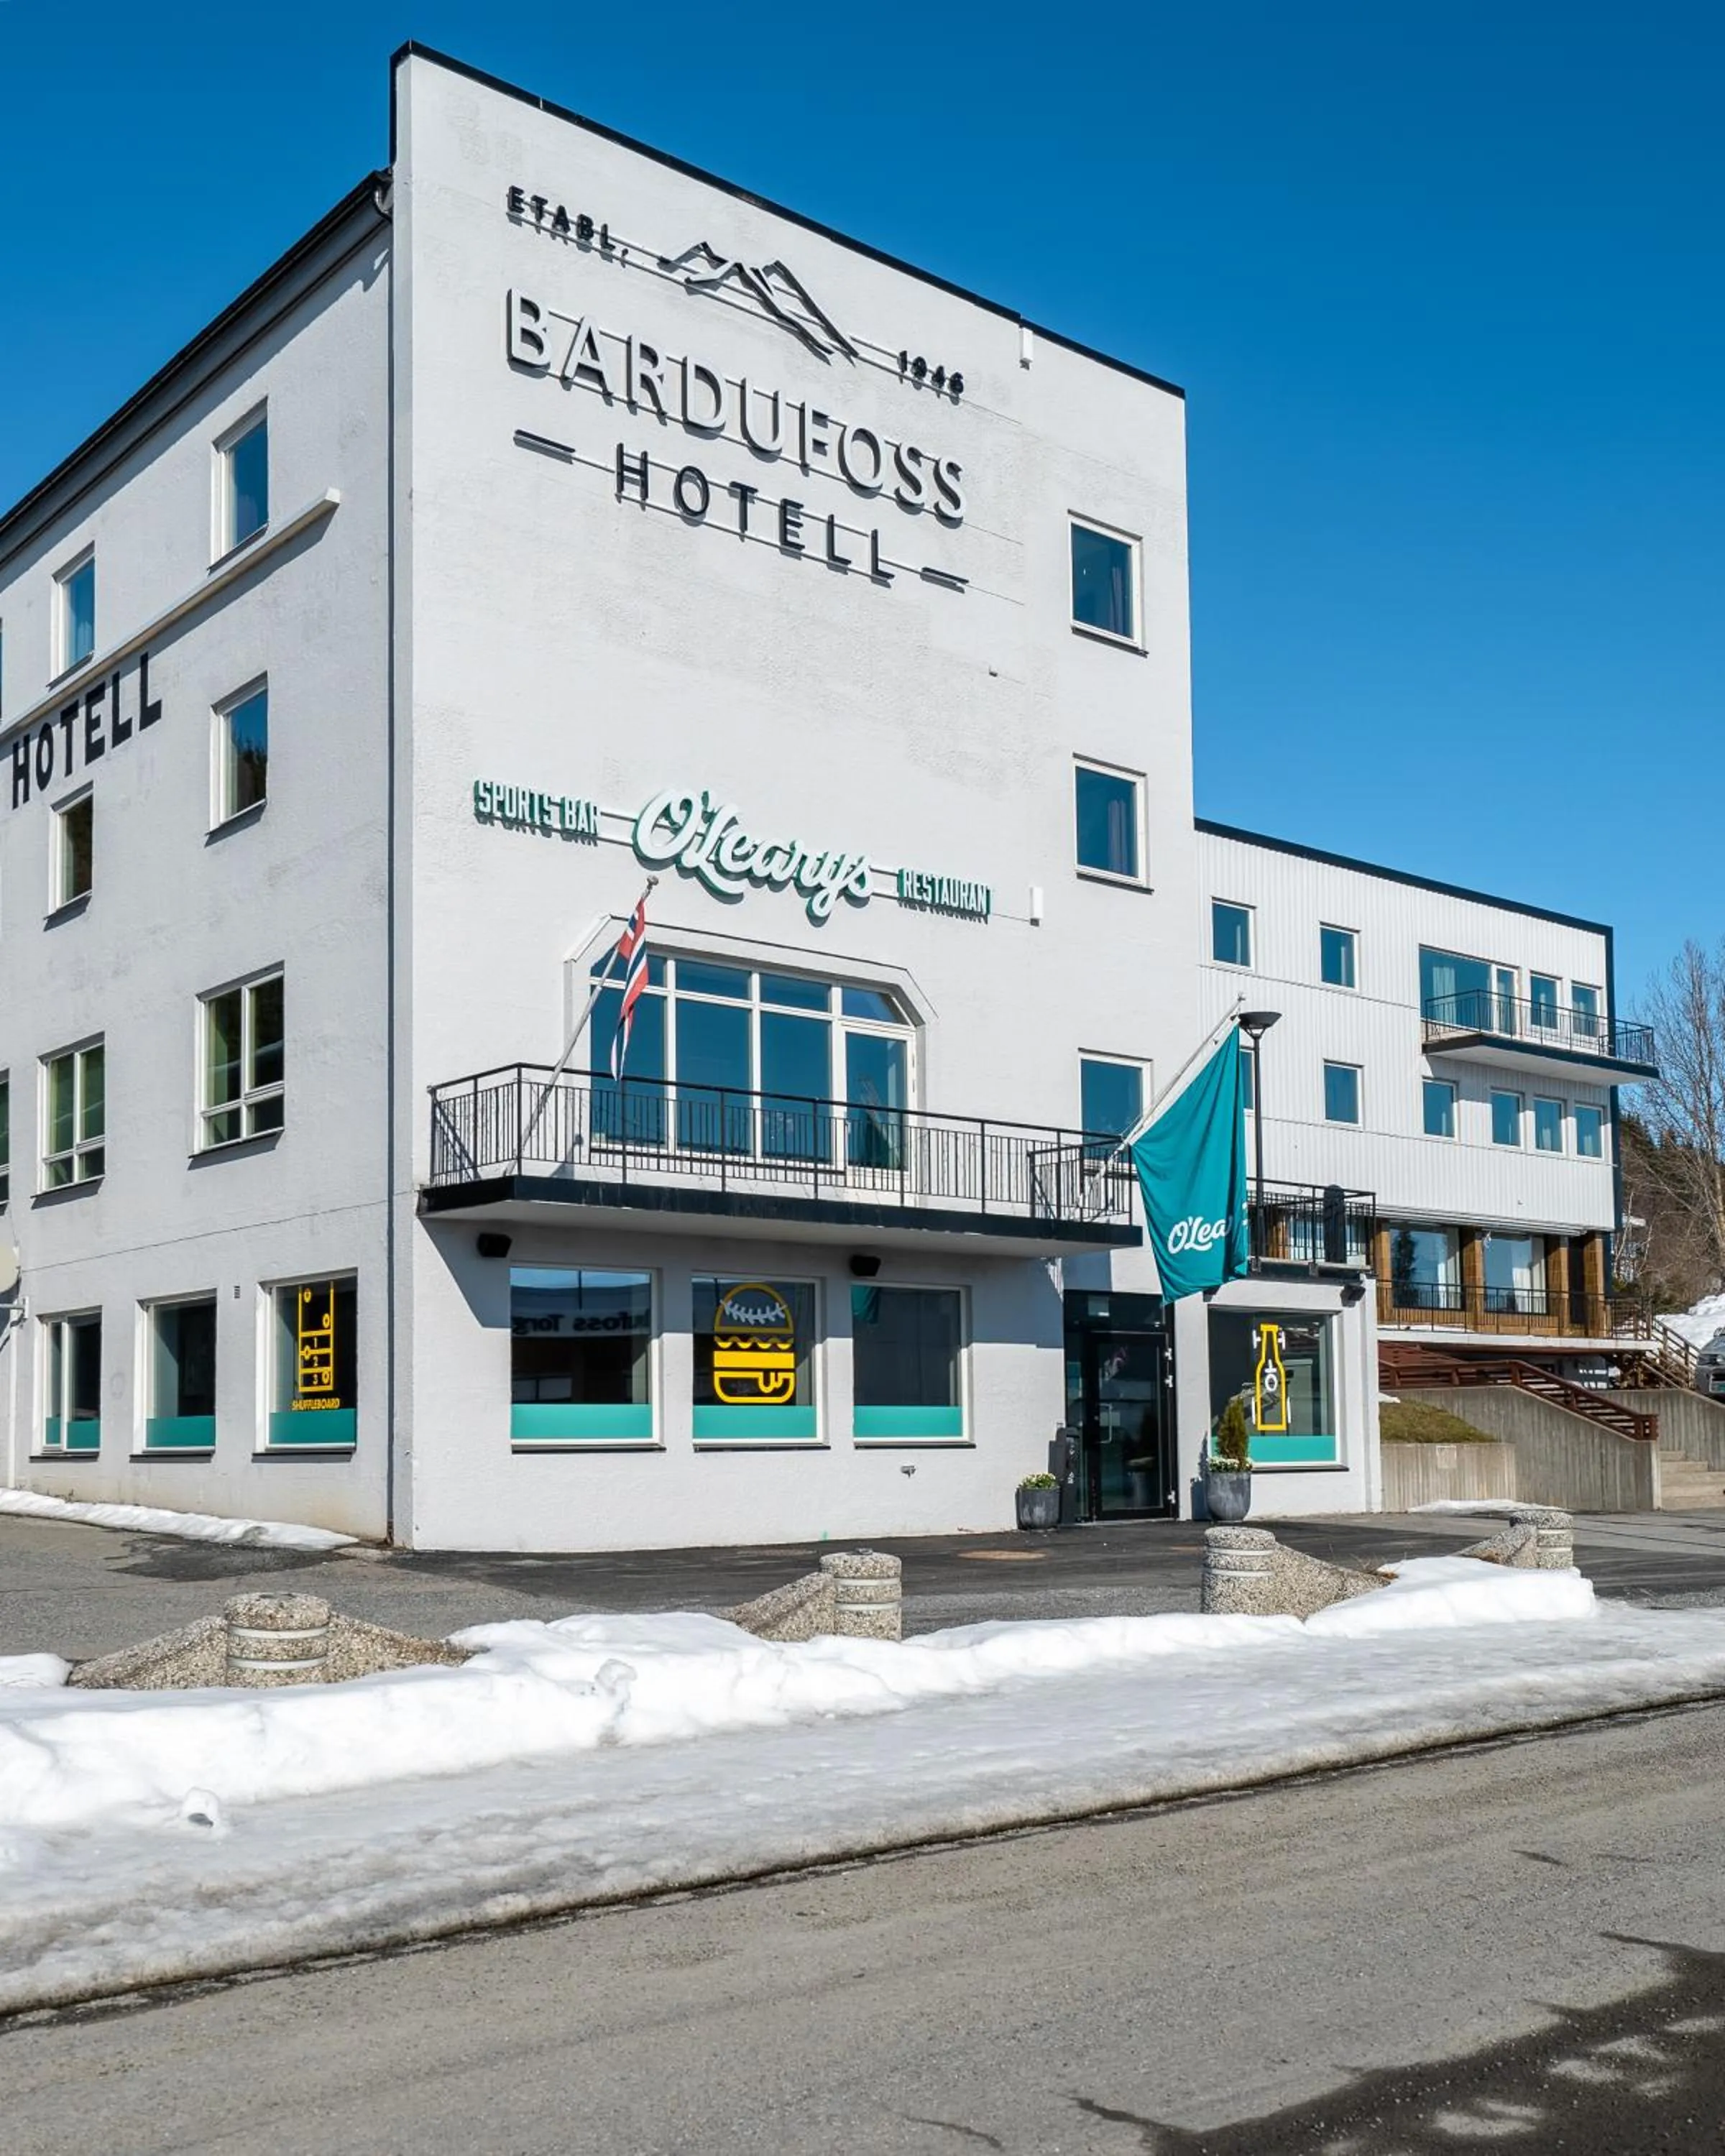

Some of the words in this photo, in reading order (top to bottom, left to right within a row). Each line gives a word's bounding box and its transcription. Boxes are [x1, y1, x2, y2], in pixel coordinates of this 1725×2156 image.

[898, 350, 964, 395] 1946
[507, 288, 969, 519] BARDUFOSS
[616, 442, 895, 580] HOTELL
[12, 651, 162, 811] HOTELL
[474, 779, 553, 826] SPORTS
[561, 796, 600, 835] BAR
[1167, 1215, 1235, 1254] O'Lea
[313, 1355, 318, 1367] 2
[313, 1373, 318, 1385] 3
